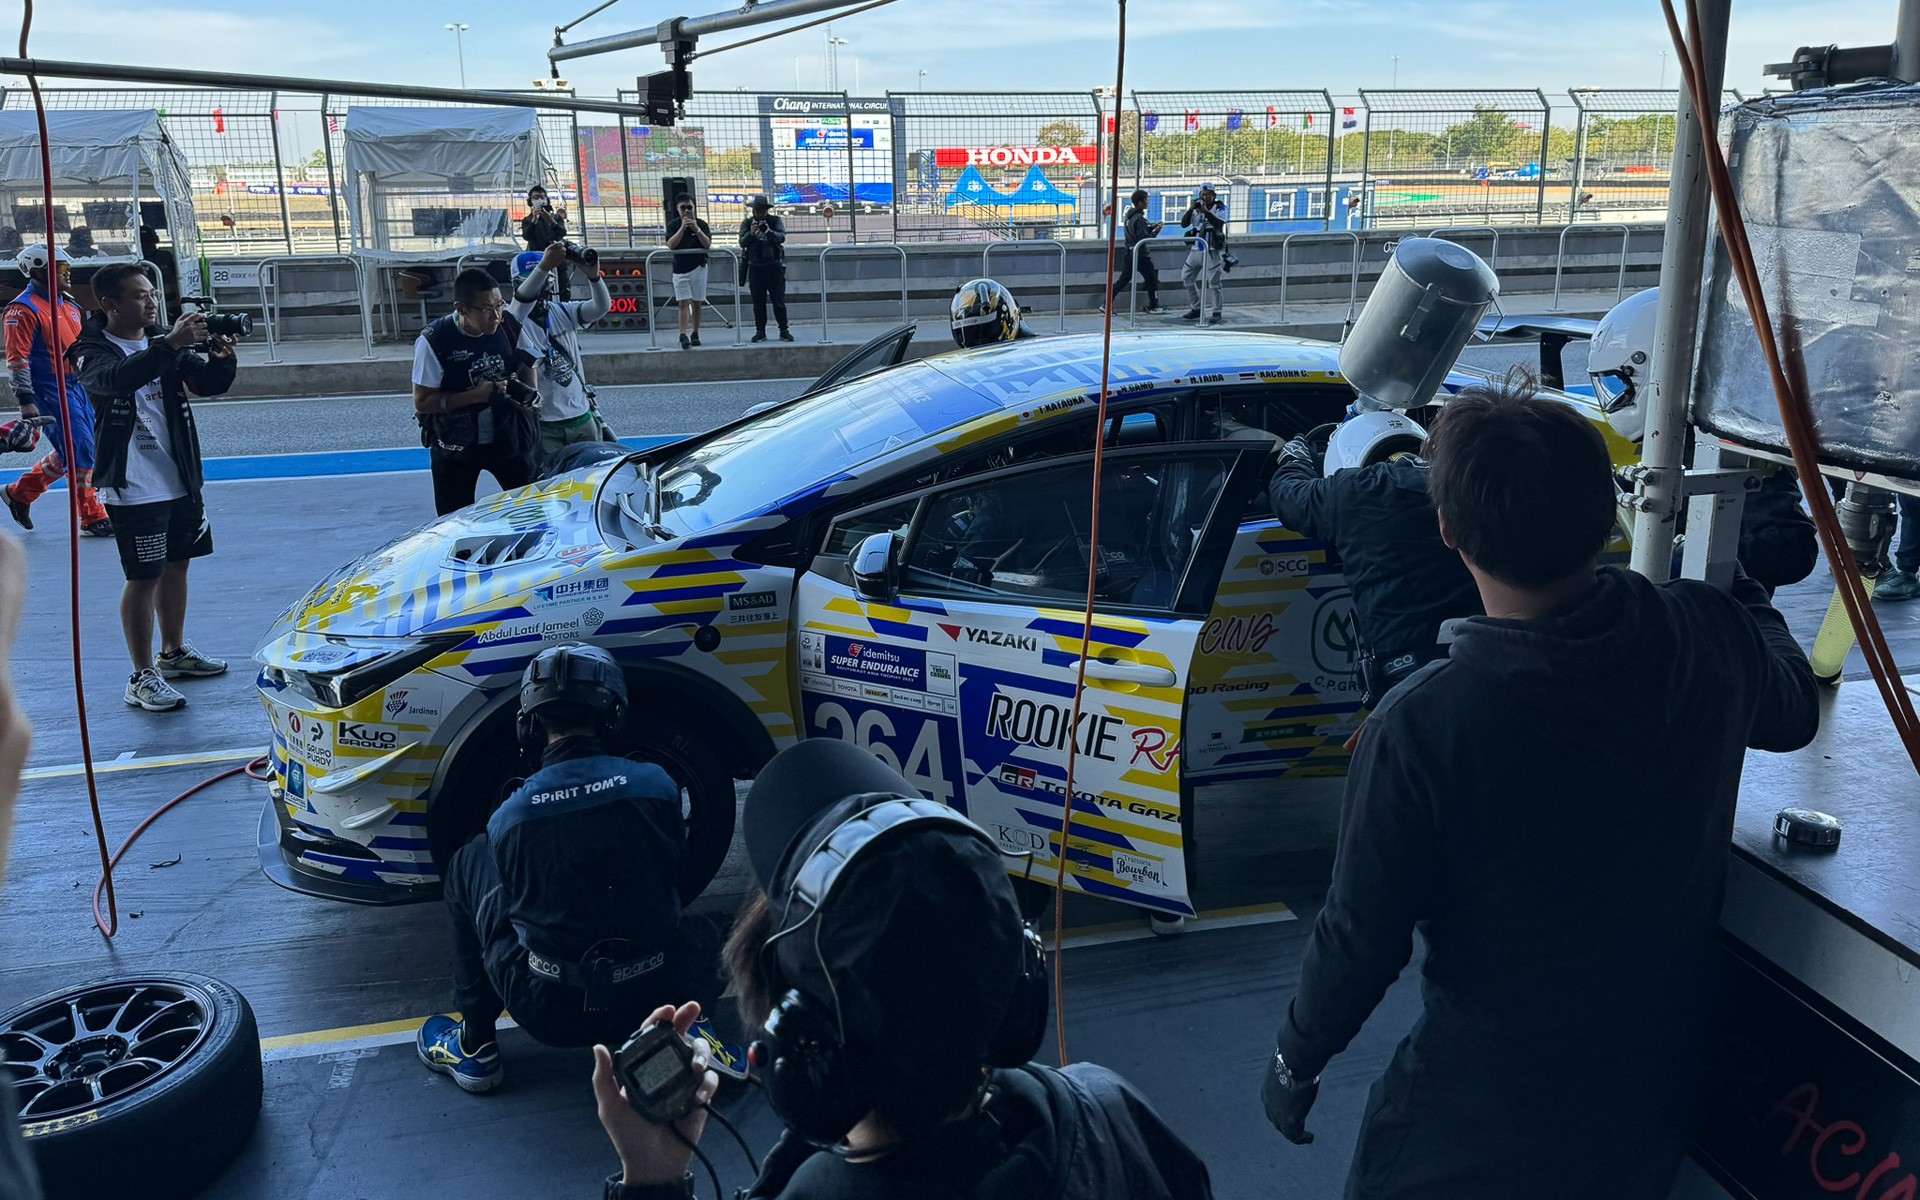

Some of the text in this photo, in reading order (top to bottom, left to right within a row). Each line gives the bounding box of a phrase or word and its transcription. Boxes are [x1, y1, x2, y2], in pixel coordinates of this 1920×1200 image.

[773, 97, 811, 112] Chang
[811, 102, 864, 110] INTERNATNAL
[966, 147, 1080, 165] HONDA
[214, 271, 229, 281] 28
[609, 299, 637, 312] BOX
[1038, 395, 1086, 415] T.KATAOKA
[1278, 559, 1308, 573] SCG
[556, 577, 609, 594] 中升集团
[533, 602, 558, 610] LIFETIME
[559, 598, 585, 606] PARTNER
[733, 595, 774, 606] MS&AD
[730, 612, 779, 623] 三井住友海上
[479, 618, 579, 643] Abdul Latif Jameel
[544, 631, 580, 641] MOTORS
[965, 627, 1037, 652] YAZAKI
[863, 647, 900, 662] idemitsu
[831, 655, 920, 678] SUPER ENDURANCE
[836, 666, 867, 675] SOUTHEAST
[810, 678, 832, 688] idemitsu
[837, 684, 858, 693] TOYOTA
[1212, 681, 1270, 693] Racing
[1314, 676, 1360, 692] C.P.GR
[408, 705, 438, 716] Jardines
[987, 693, 1123, 762] ROOKIE
[339, 738, 396, 749] GROUP
[307, 754, 332, 767] PURDY
[584, 775, 628, 794] TOM'S
[1001, 774, 1034, 789] GR
[1041, 780, 1122, 810] TOYOTA
[998, 824, 1045, 850] KOD
[1123, 854, 1152, 867] Trattoria
[1116, 857, 1161, 884] Bourbon
